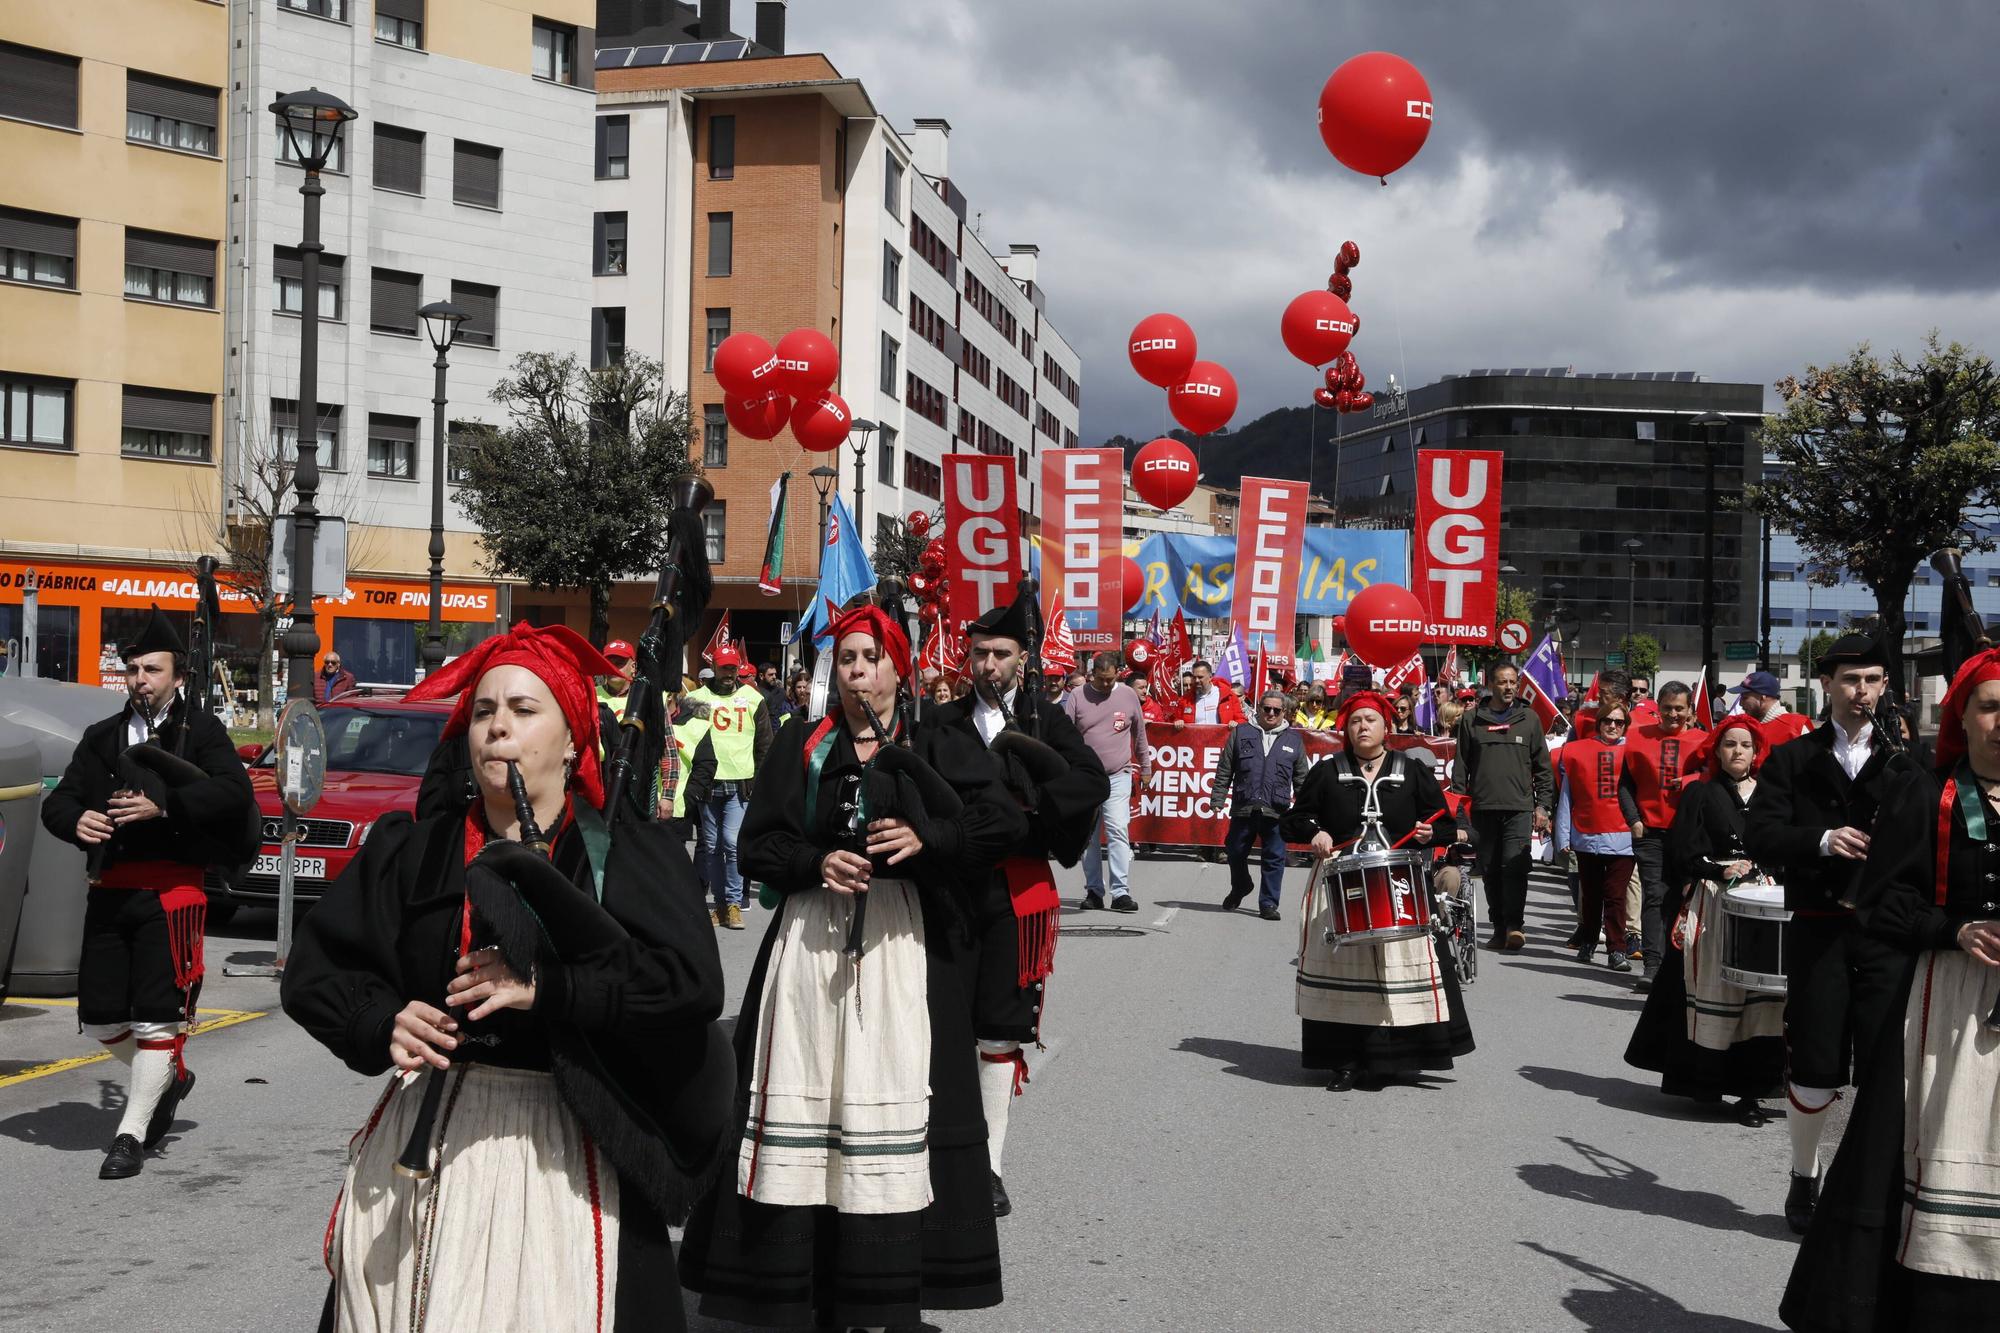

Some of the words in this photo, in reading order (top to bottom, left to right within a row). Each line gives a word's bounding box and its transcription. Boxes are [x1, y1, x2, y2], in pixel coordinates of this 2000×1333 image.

[1316, 319, 1354, 335] CCOO
[1132, 339, 1176, 354] CCOO
[1175, 383, 1222, 398] CCOO
[1144, 459, 1190, 472] CCOO
[956, 462, 1010, 616] UGT
[1064, 455, 1100, 608] CCOO
[1427, 458, 1489, 619] UGT
[1250, 487, 1290, 630] CCOO
[36, 571, 97, 591] FÁBRICA
[364, 589, 397, 604] TOR
[400, 591, 488, 609] PINURAS
[1369, 619, 1422, 633] CCOO
[1387, 653, 1424, 690] CCOO
[1148, 745, 1195, 769] POR
[1144, 770, 1234, 795] MENO
[1391, 876, 1414, 921] Pearl
